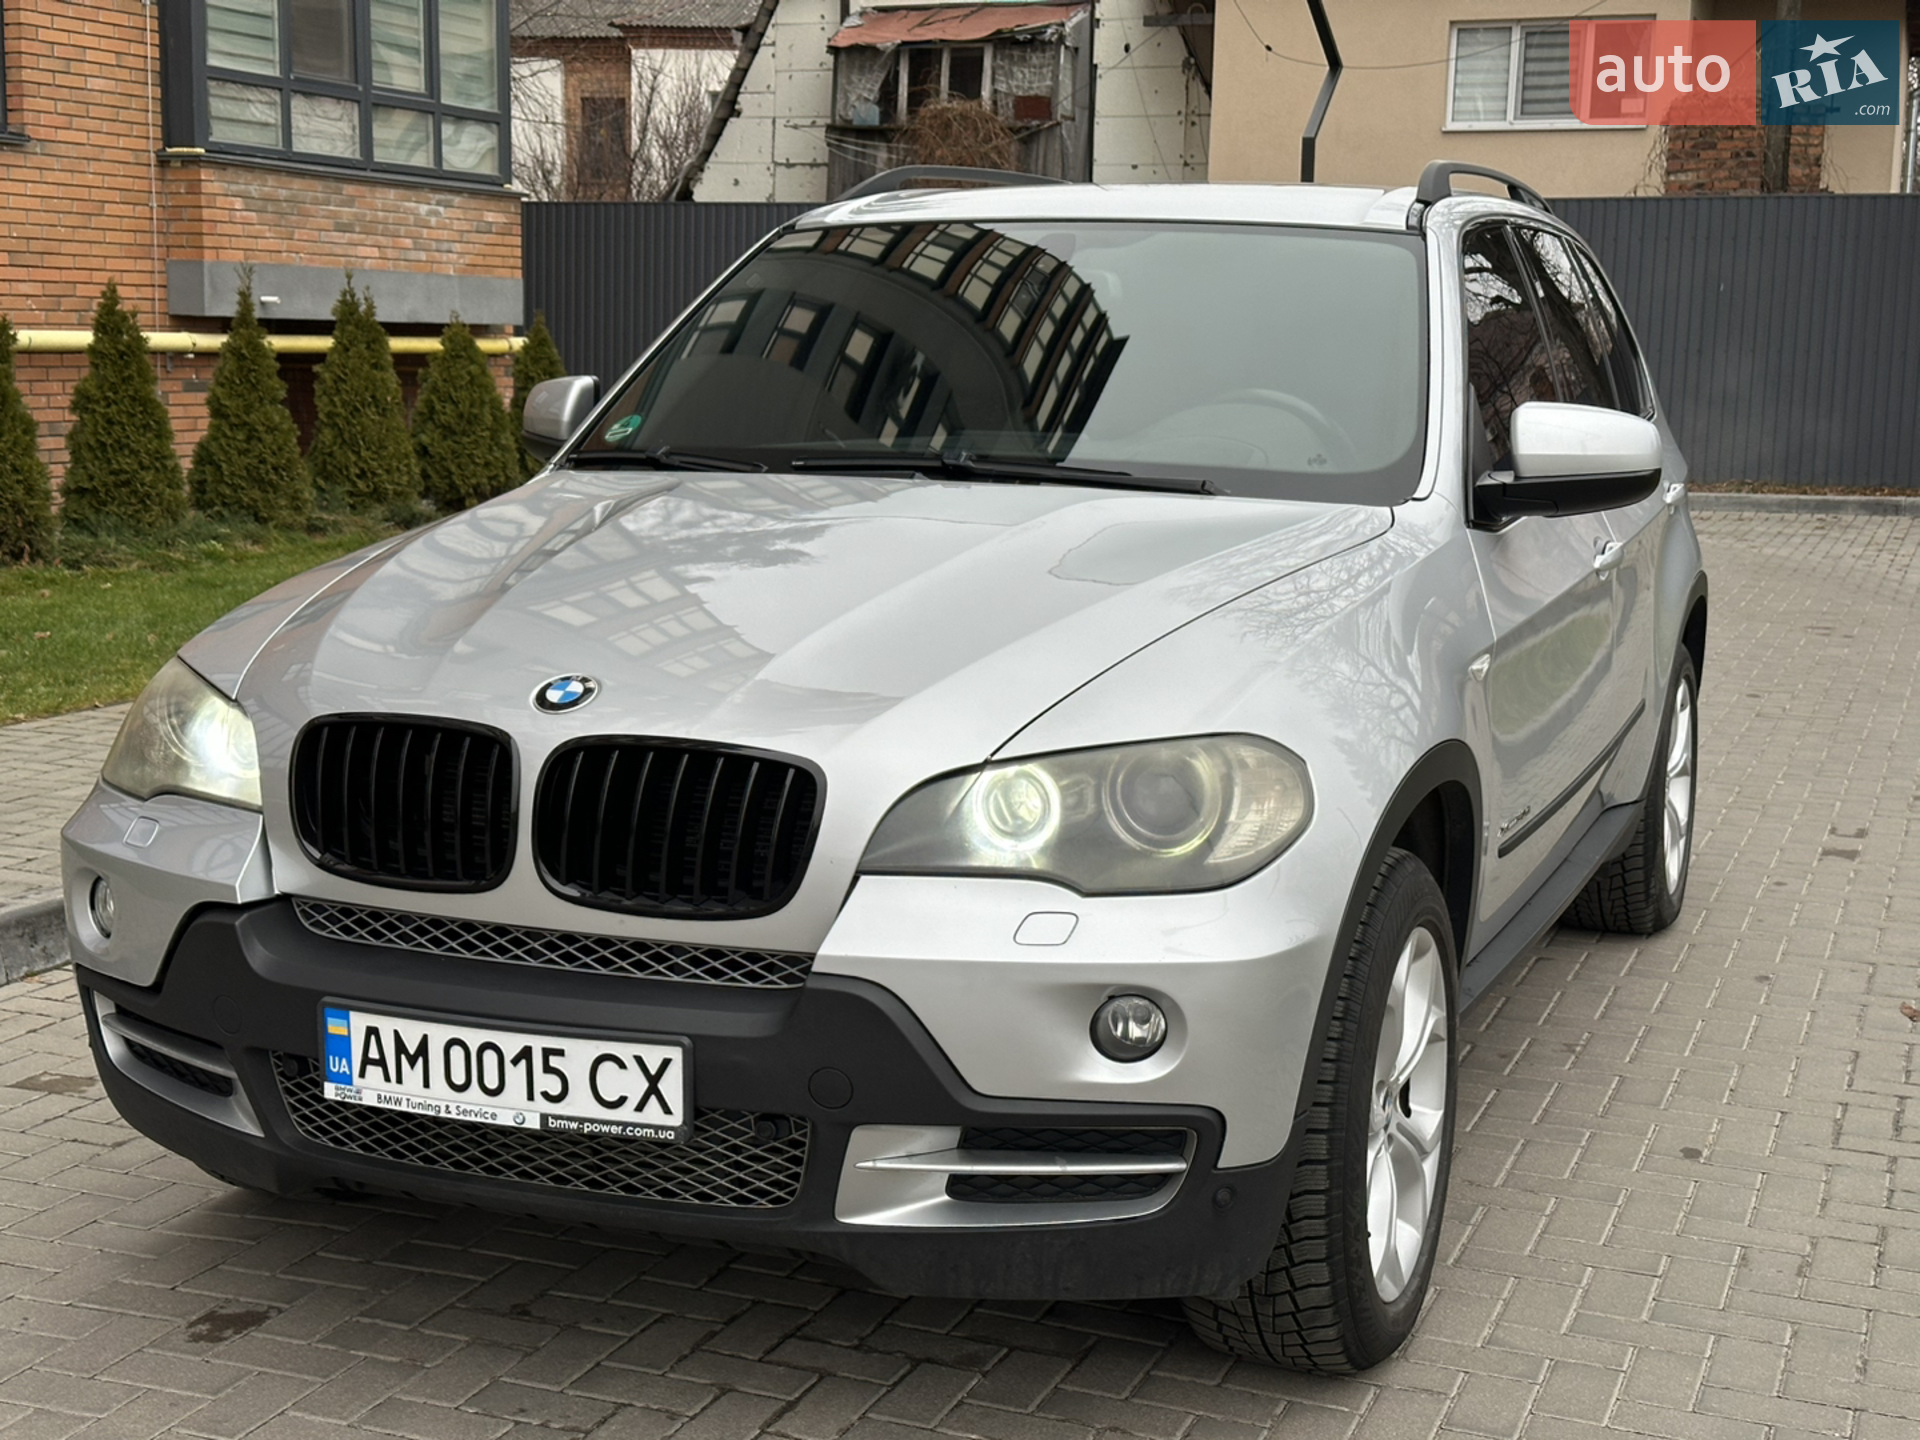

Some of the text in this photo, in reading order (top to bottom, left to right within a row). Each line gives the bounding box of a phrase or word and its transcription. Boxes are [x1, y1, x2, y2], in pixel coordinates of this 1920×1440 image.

[329, 1055, 350, 1075] UA
[358, 1024, 675, 1116] AM 0015 CX
[376, 1093, 498, 1121] BMW Tuning & Service
[548, 1115, 675, 1140] bmw-power.com.ua
